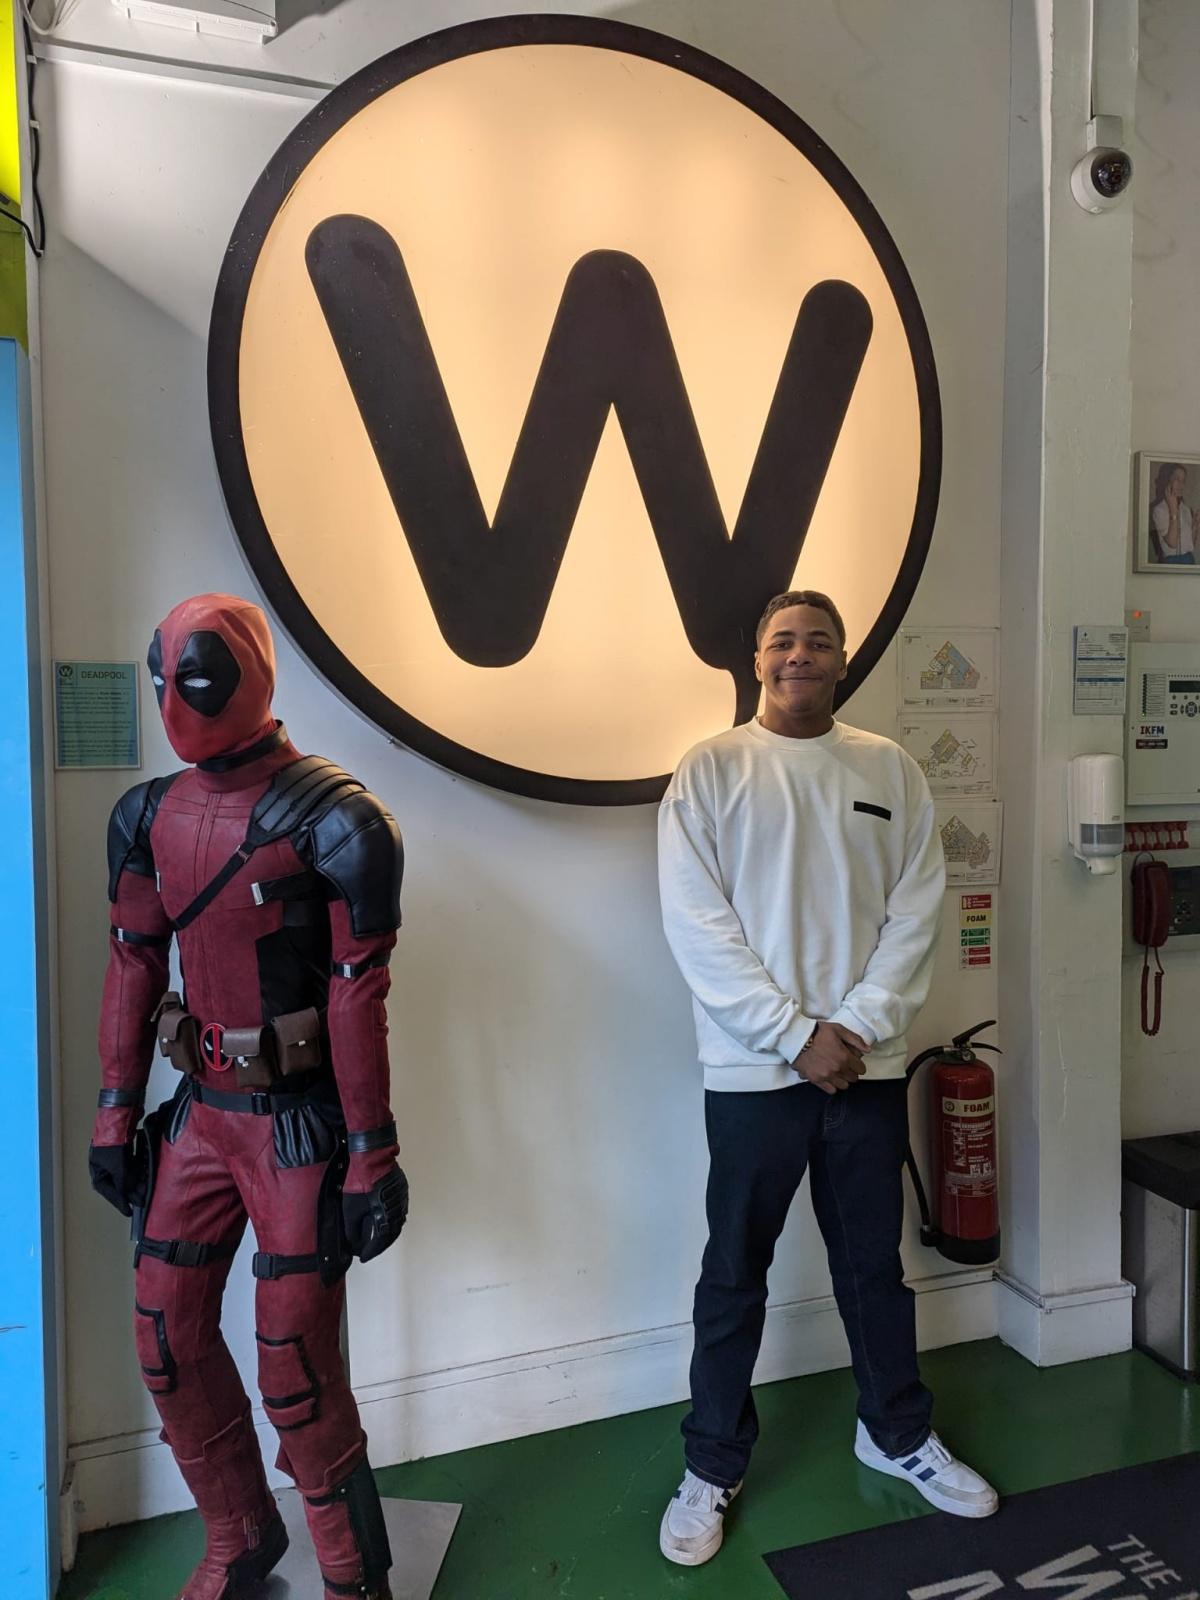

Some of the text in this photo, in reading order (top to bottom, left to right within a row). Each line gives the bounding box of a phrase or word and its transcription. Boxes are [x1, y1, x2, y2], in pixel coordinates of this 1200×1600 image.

[304, 213, 874, 668] W
[81, 671, 127, 679] DEADPOOL
[1140, 725, 1165, 735] IKFM
[966, 914, 986, 922] FOAM
[963, 1102, 990, 1113] FOAM
[1107, 1533, 1181, 1589] THE
